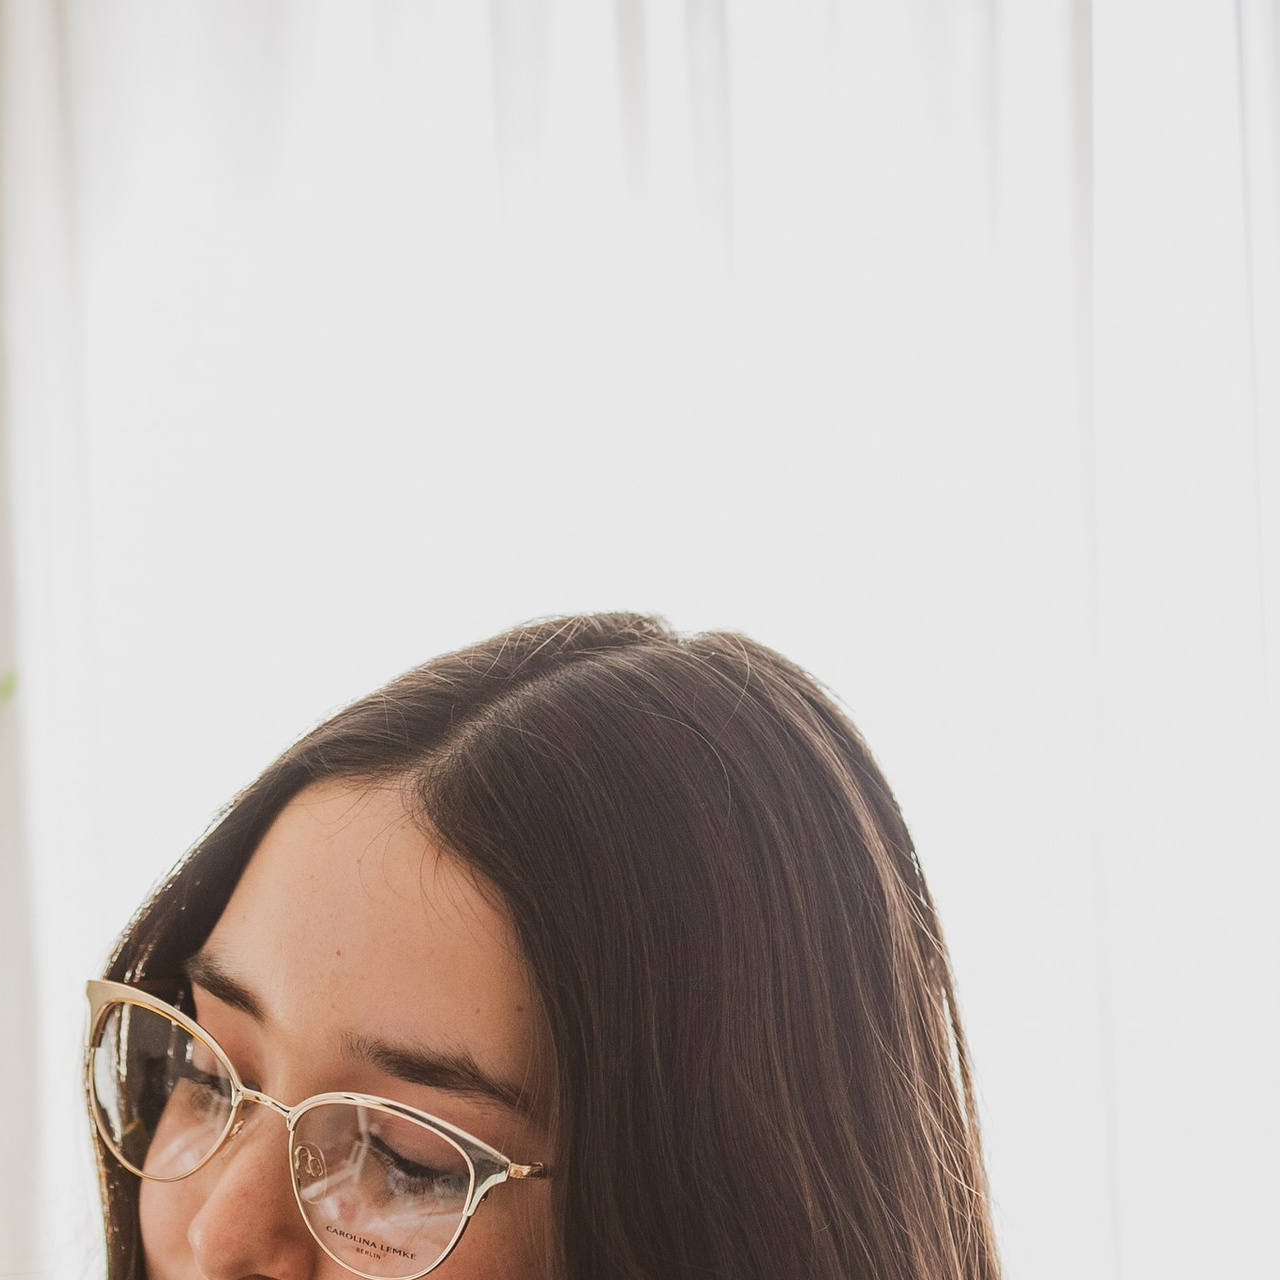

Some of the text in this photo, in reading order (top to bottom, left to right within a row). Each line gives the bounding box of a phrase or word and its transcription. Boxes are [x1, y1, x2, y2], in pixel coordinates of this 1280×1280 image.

[326, 1225, 417, 1260] CAROLINA LEMKE
[355, 1247, 381, 1259] BERLIN
